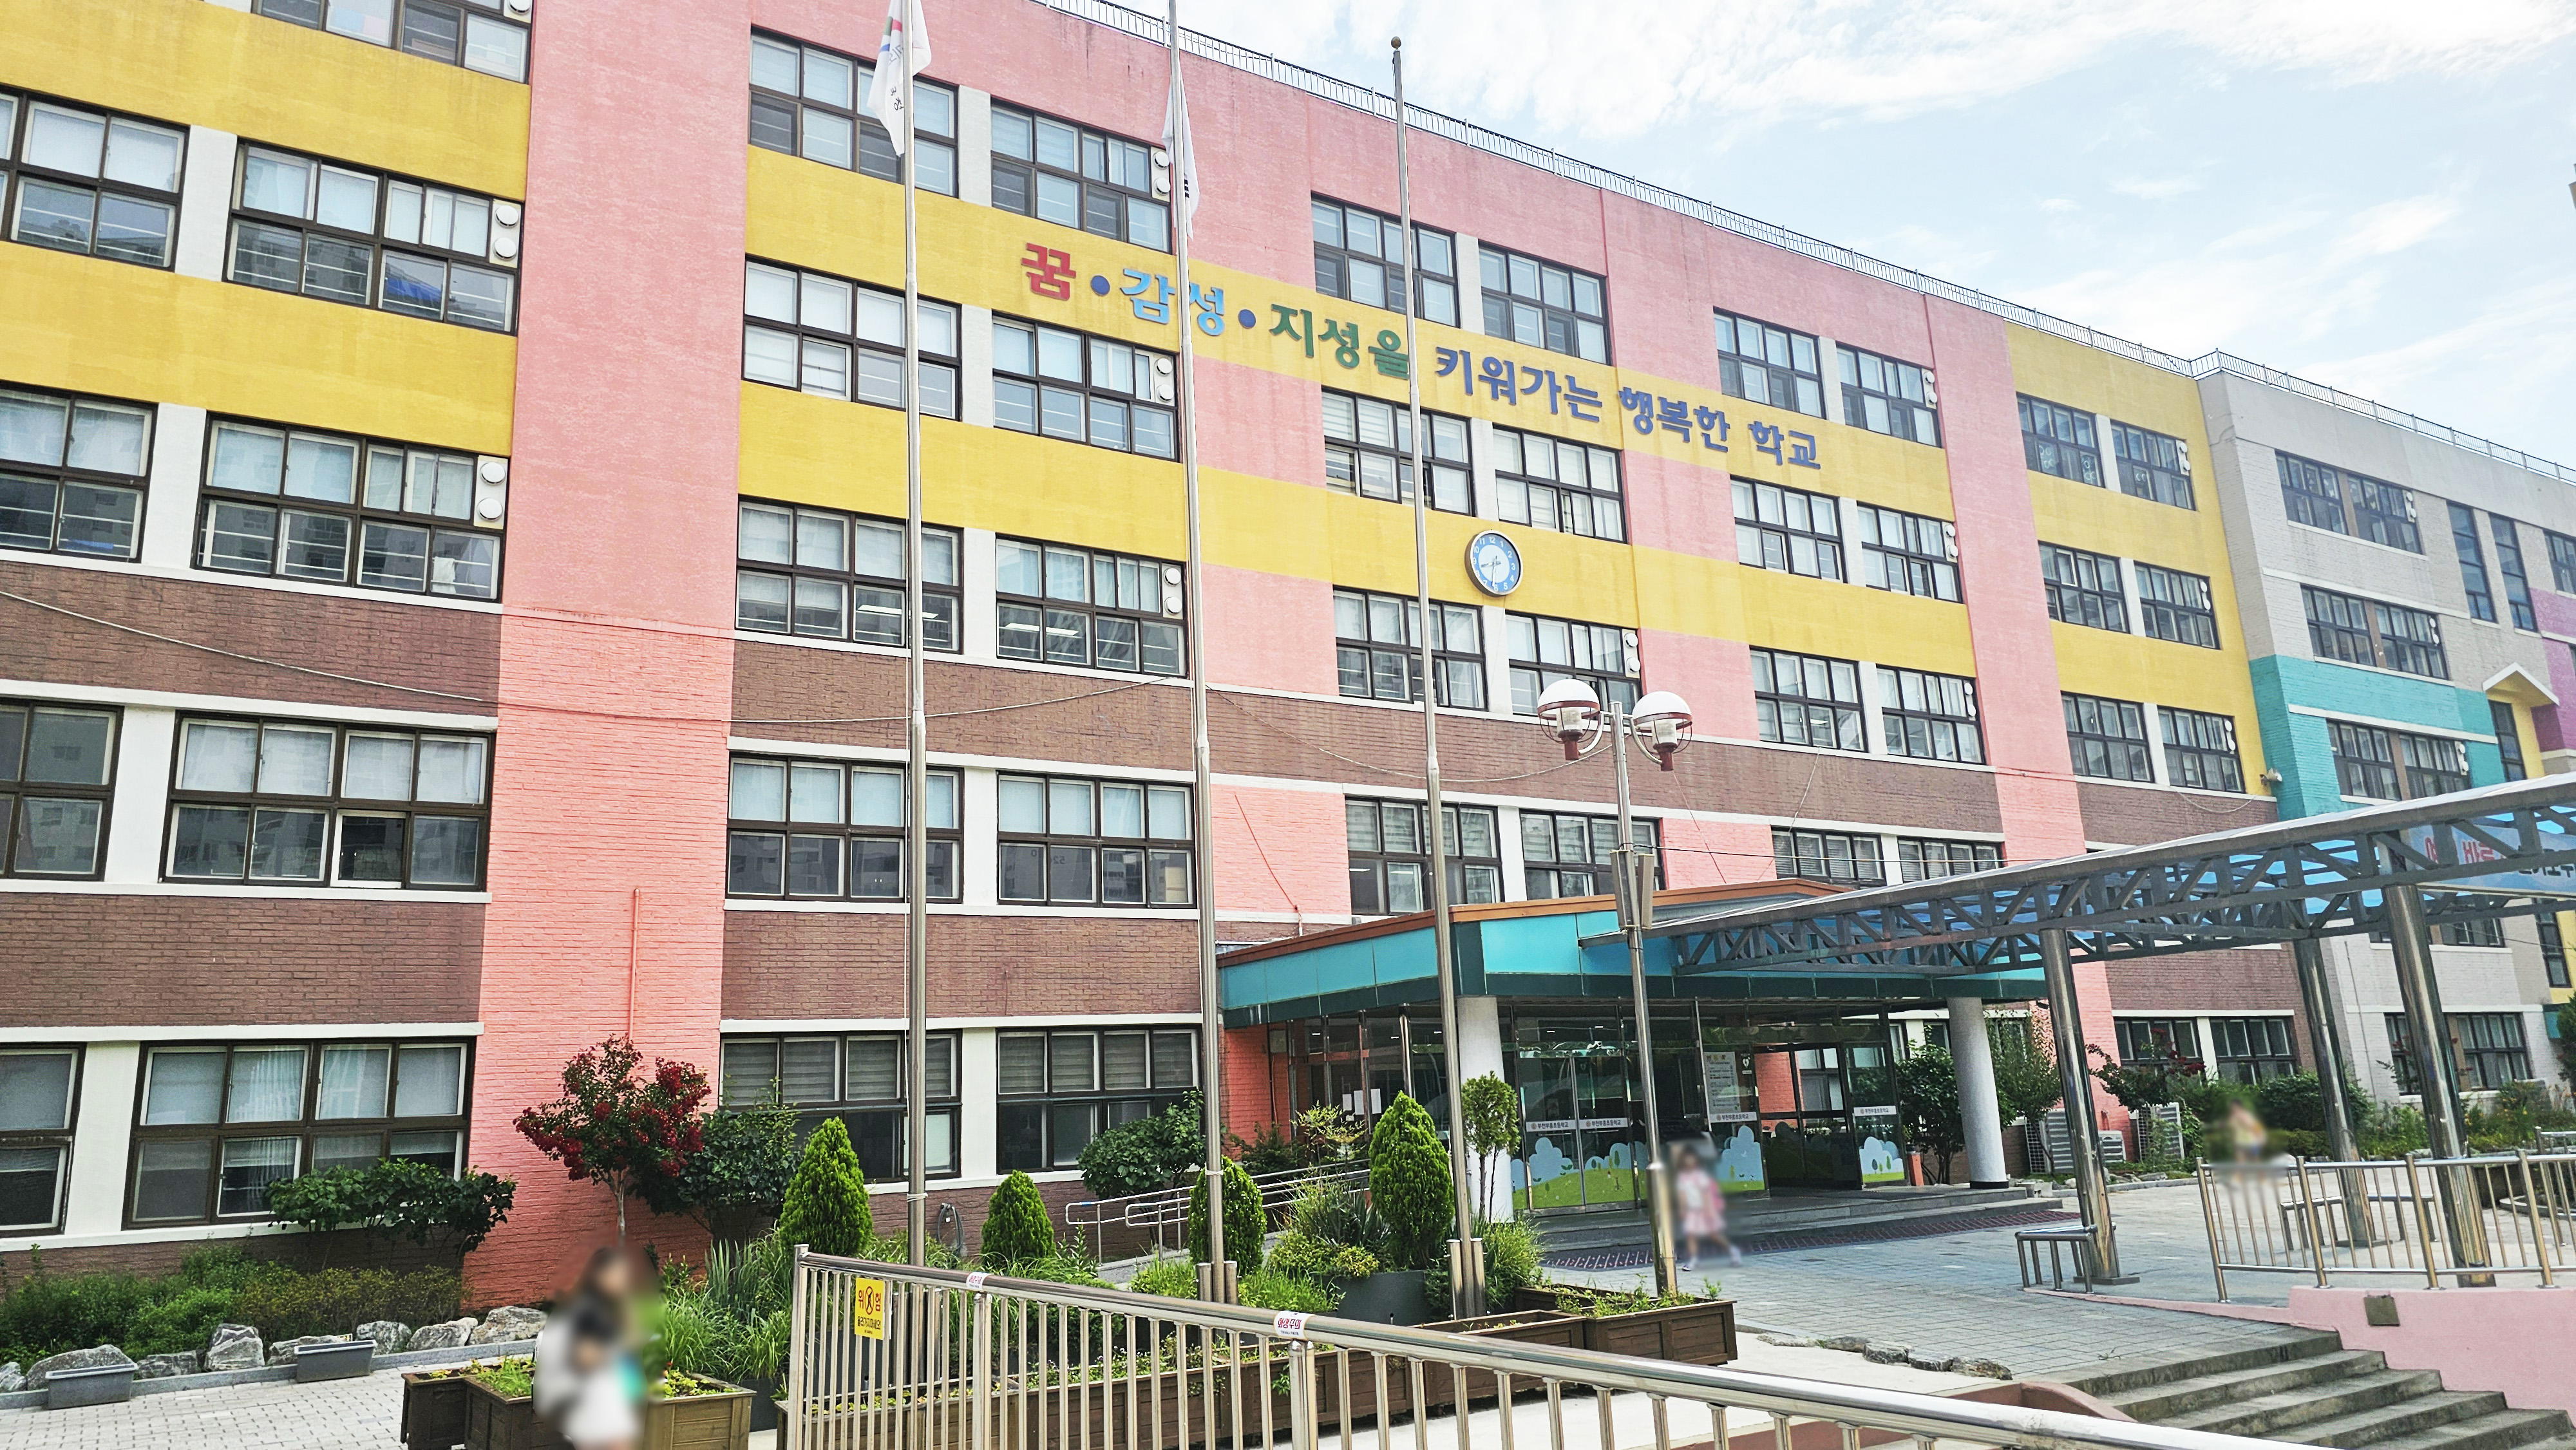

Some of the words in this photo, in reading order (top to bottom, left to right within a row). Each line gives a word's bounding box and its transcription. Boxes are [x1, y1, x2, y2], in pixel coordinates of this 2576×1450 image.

[1021, 243, 1076, 301] 꿈
[1121, 268, 1224, 336] 감성
[1269, 303, 1409, 381] 지성을
[1434, 346, 1603, 422] 키워가는
[1619, 386, 1730, 453] 행복한
[1748, 420, 1821, 470] 학교
